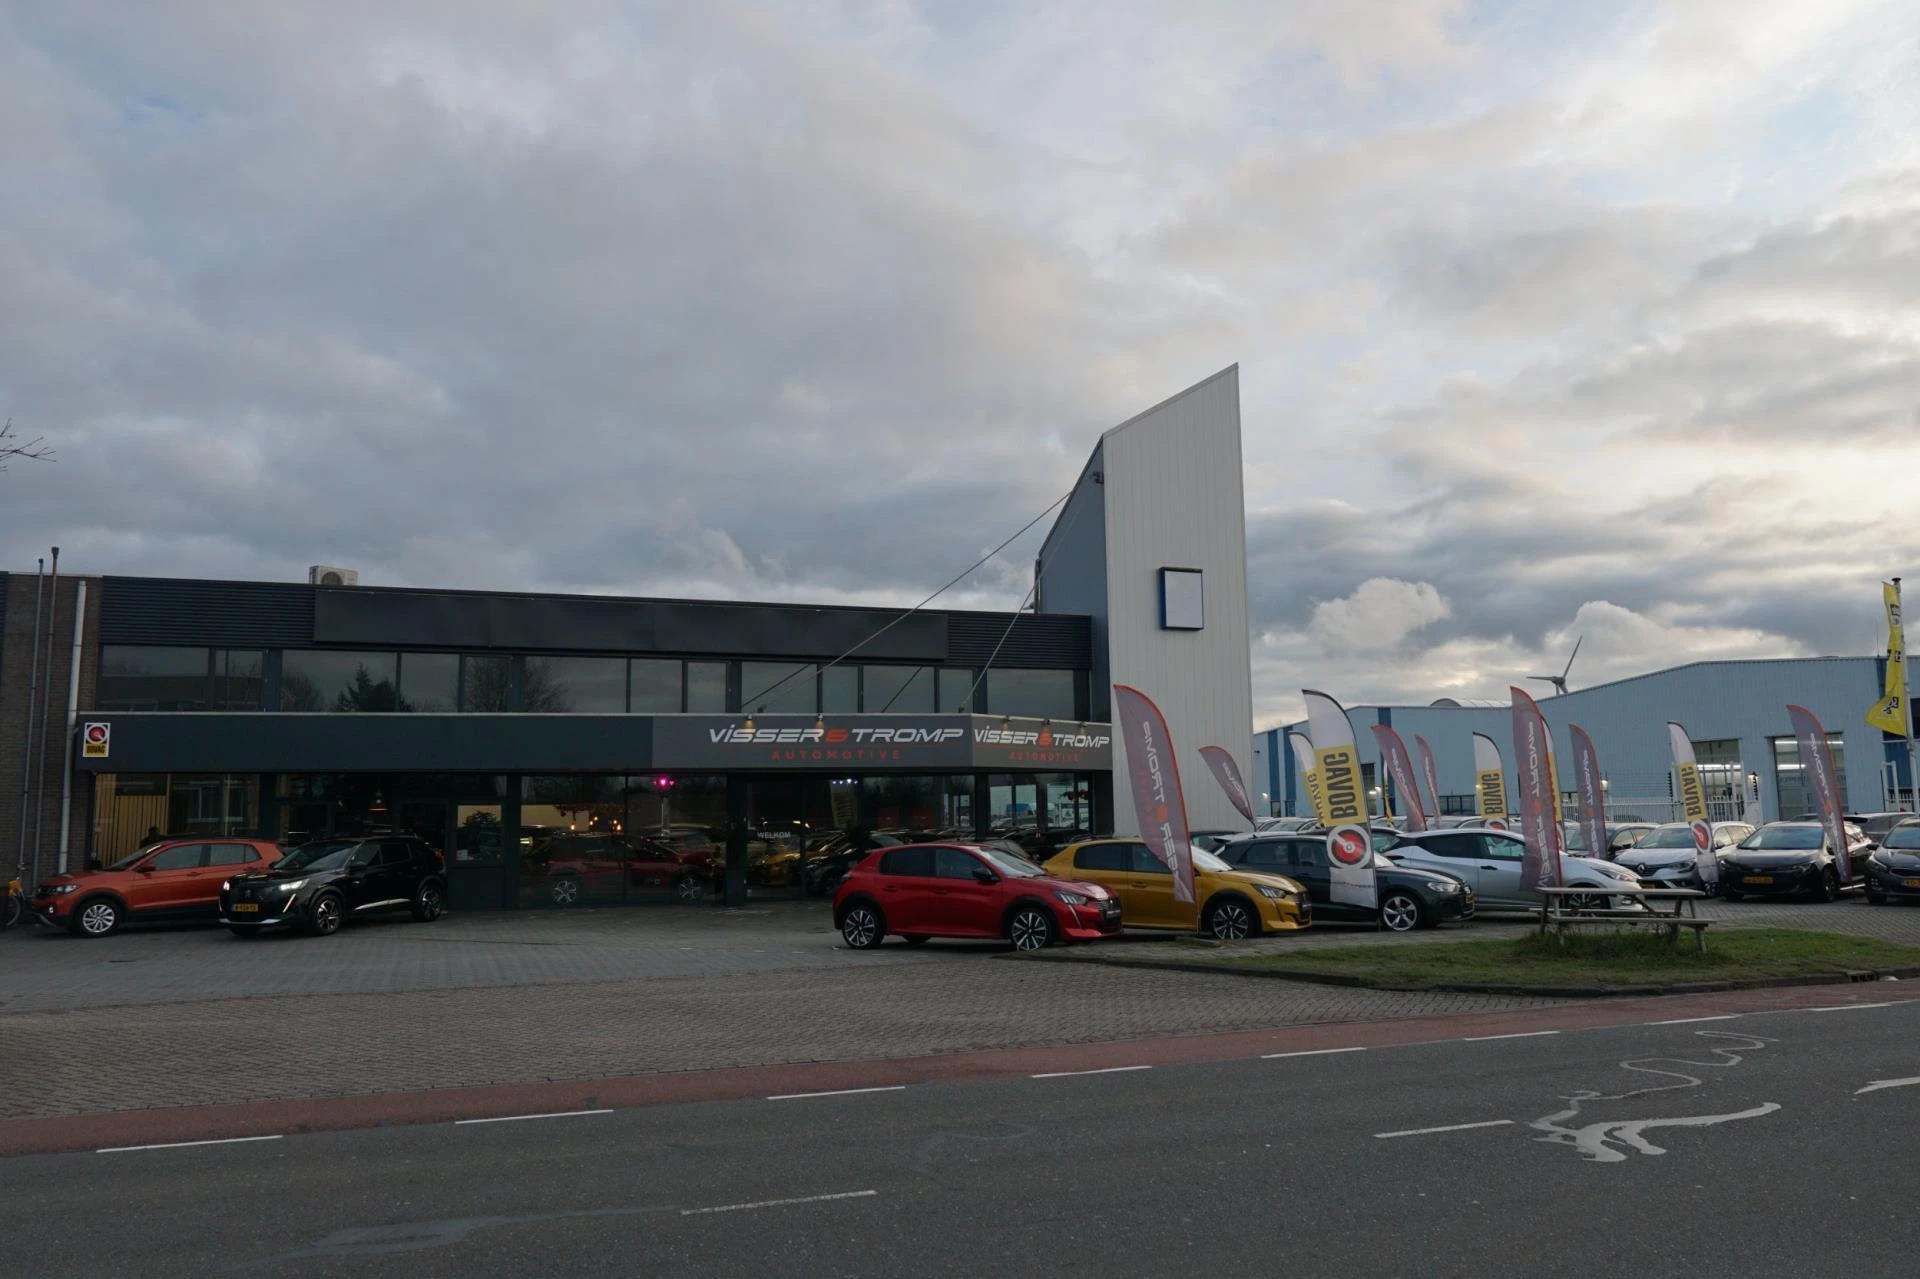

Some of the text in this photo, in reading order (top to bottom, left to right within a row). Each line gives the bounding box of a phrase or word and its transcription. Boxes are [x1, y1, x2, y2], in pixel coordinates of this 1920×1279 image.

[852, 728, 964, 743] TROMP
[1052, 733, 1110, 748] TROMP
[771, 750, 900, 761] AUTOMOTIVE
[1008, 751, 1080, 762] AUTOMOTIVE
[757, 831, 791, 839] WELKOM
